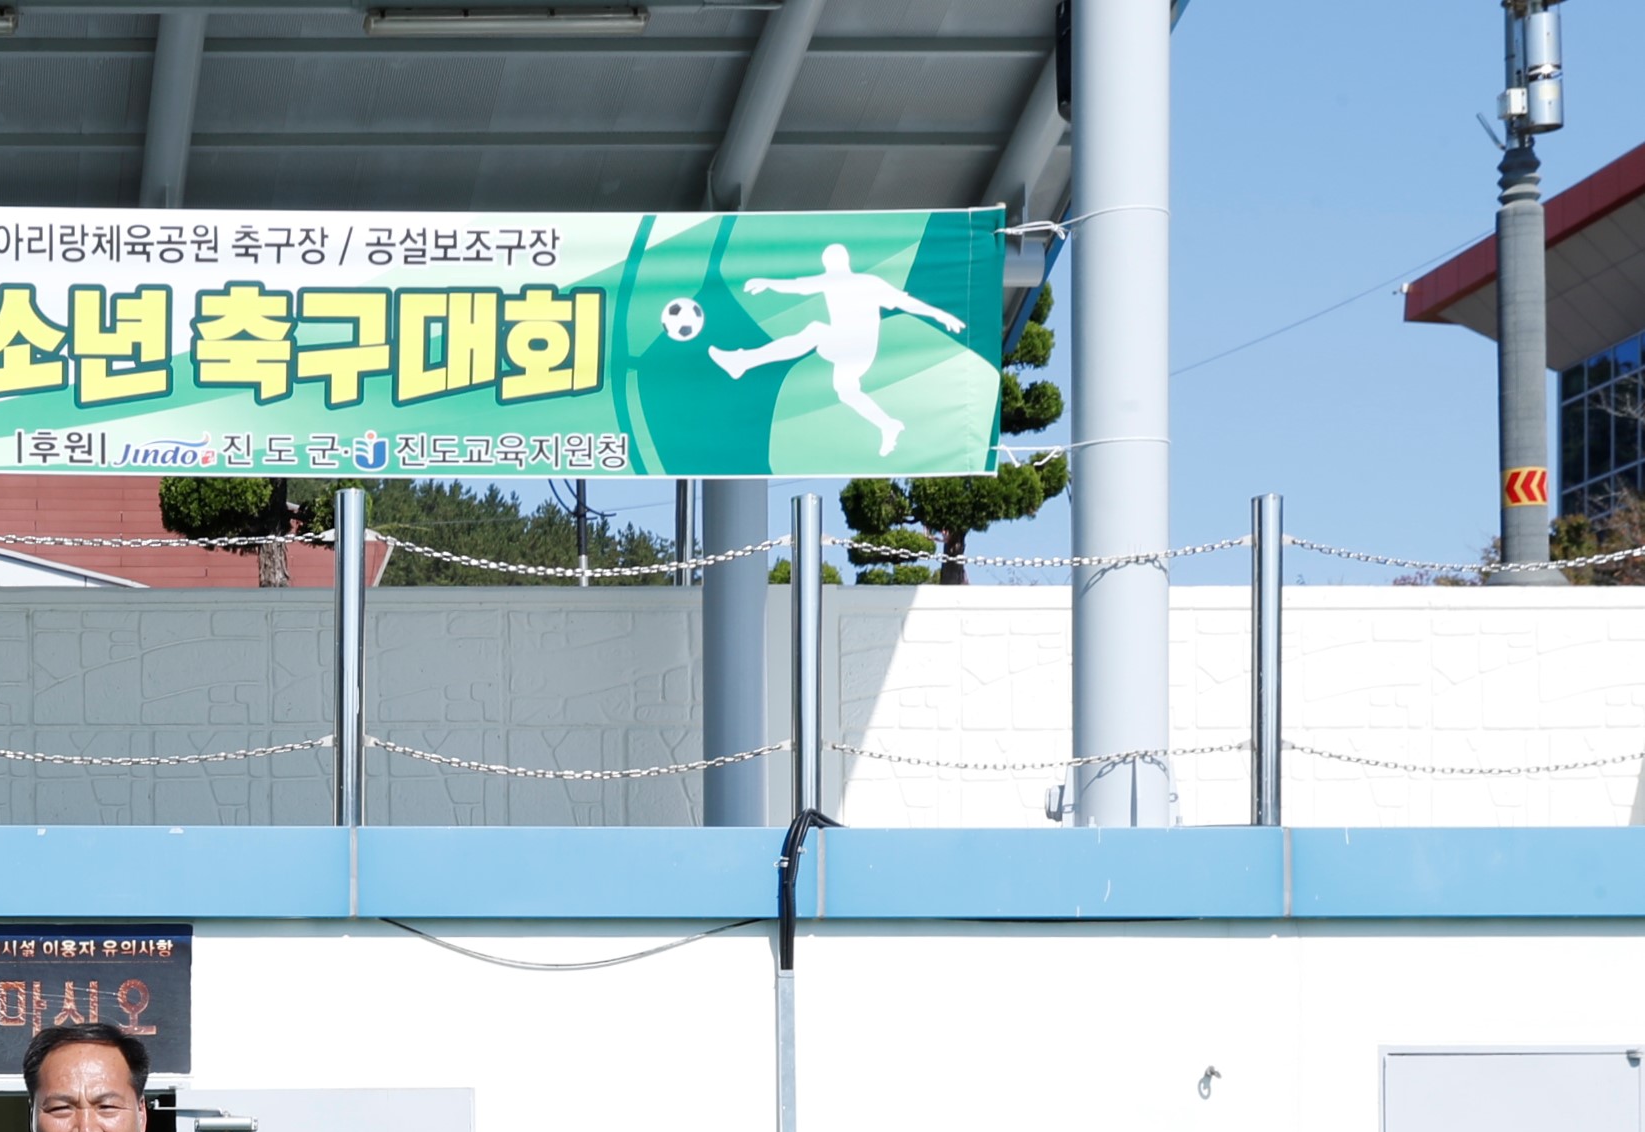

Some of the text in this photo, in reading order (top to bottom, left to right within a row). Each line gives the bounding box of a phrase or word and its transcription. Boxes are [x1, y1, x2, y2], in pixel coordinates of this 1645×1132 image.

[231, 227, 330, 266] 축구장
[365, 228, 560, 267] 공설보조구장
[191, 280, 605, 410] 축구대회
[396, 434, 628, 469] 진도교육지원청
[42, 938, 96, 959] 이용자
[101, 939, 174, 959] 유의사항
